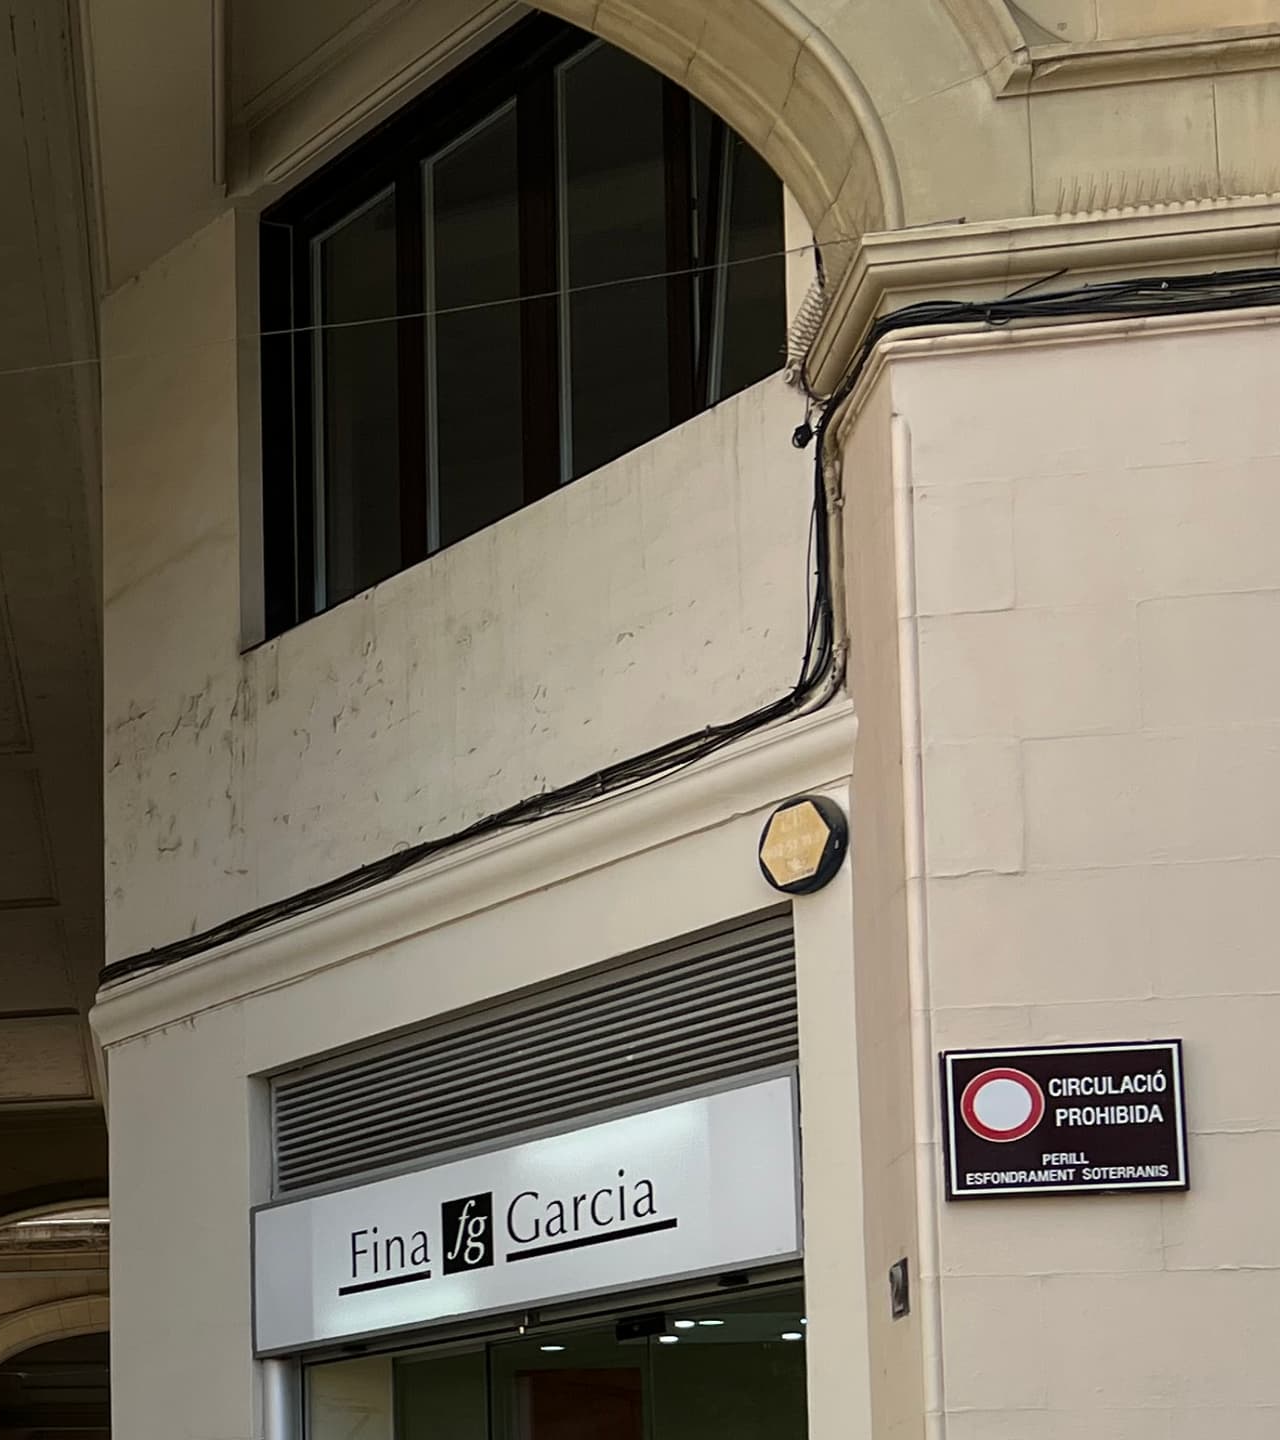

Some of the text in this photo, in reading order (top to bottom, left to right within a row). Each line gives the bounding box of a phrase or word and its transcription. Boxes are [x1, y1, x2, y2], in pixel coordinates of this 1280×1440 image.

[1048, 1069, 1167, 1097] CIRCULACIÓ
[1055, 1104, 1164, 1127] PROHIBIDA
[1042, 1152, 1090, 1166] PERILL
[965, 1165, 1169, 1186] ESFONDRAMENT SOTERRANIS
[350, 1226, 430, 1279] Fina
[505, 1168, 657, 1244] Garcia
